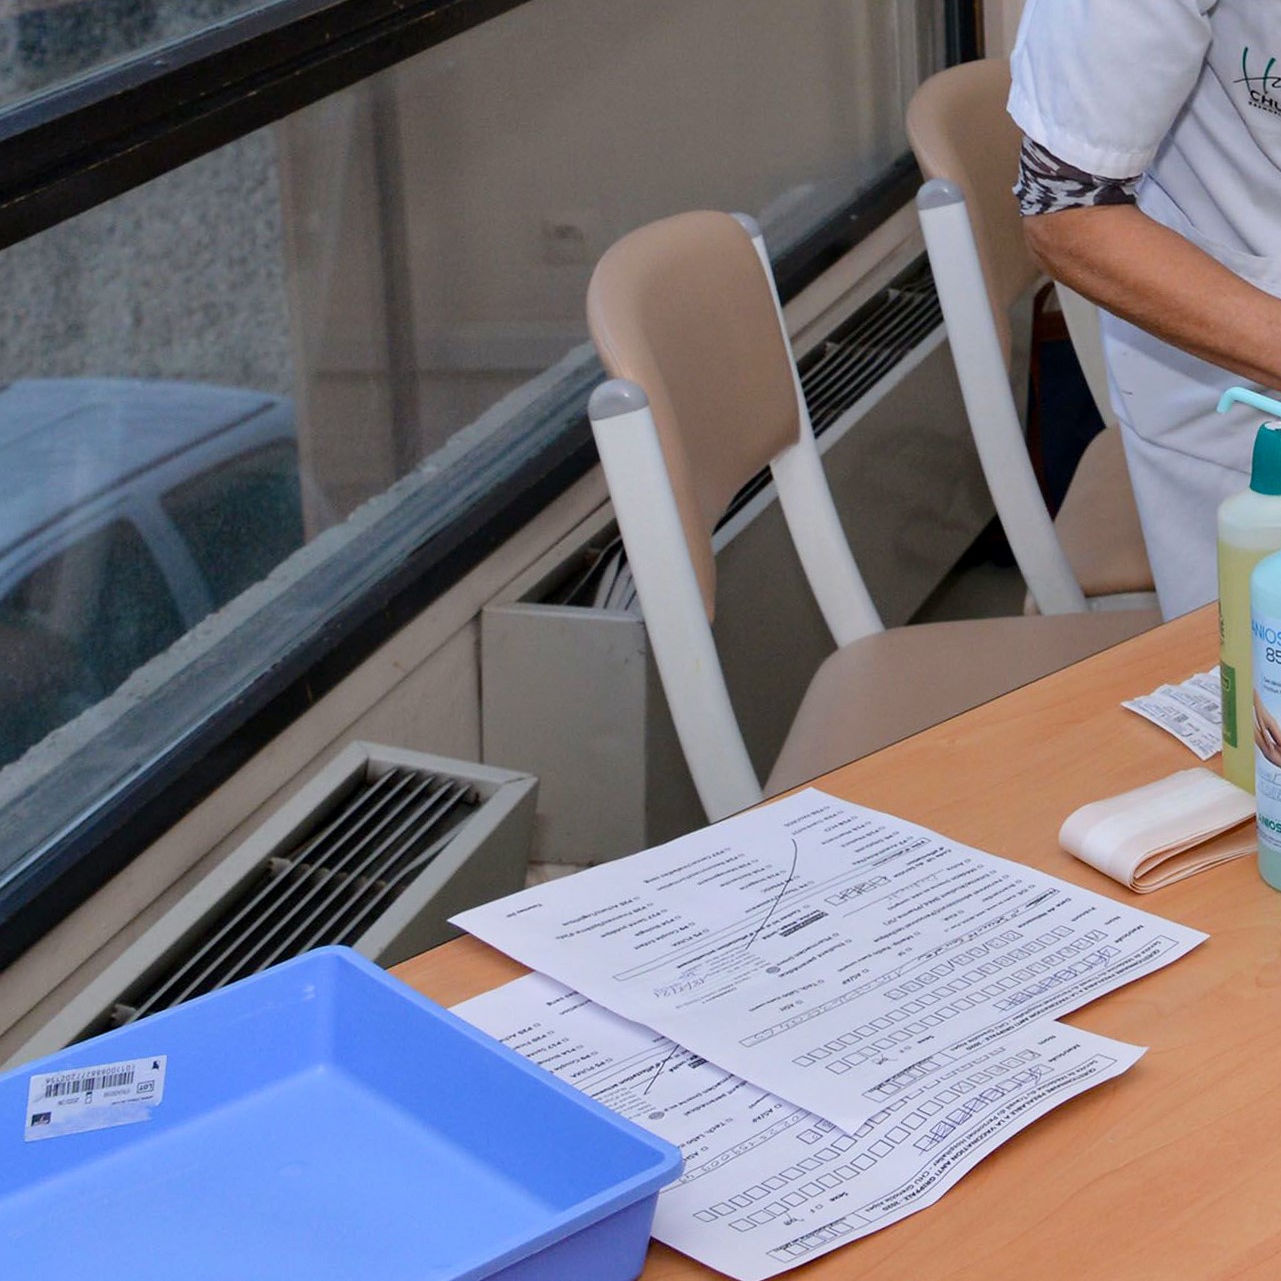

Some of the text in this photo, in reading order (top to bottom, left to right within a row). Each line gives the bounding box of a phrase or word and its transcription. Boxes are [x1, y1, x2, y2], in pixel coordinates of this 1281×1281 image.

[138, 1082, 153, 1091] LOT
[965, 1114, 997, 1140] Personnel
[950, 1124, 996, 1161] VACCINATION
[913, 1169, 930, 1185] CHU
[933, 1159, 951, 1176] ANTI
[883, 1183, 914, 1203] Grenoble
[903, 1174, 936, 1202] GRIPPALE
